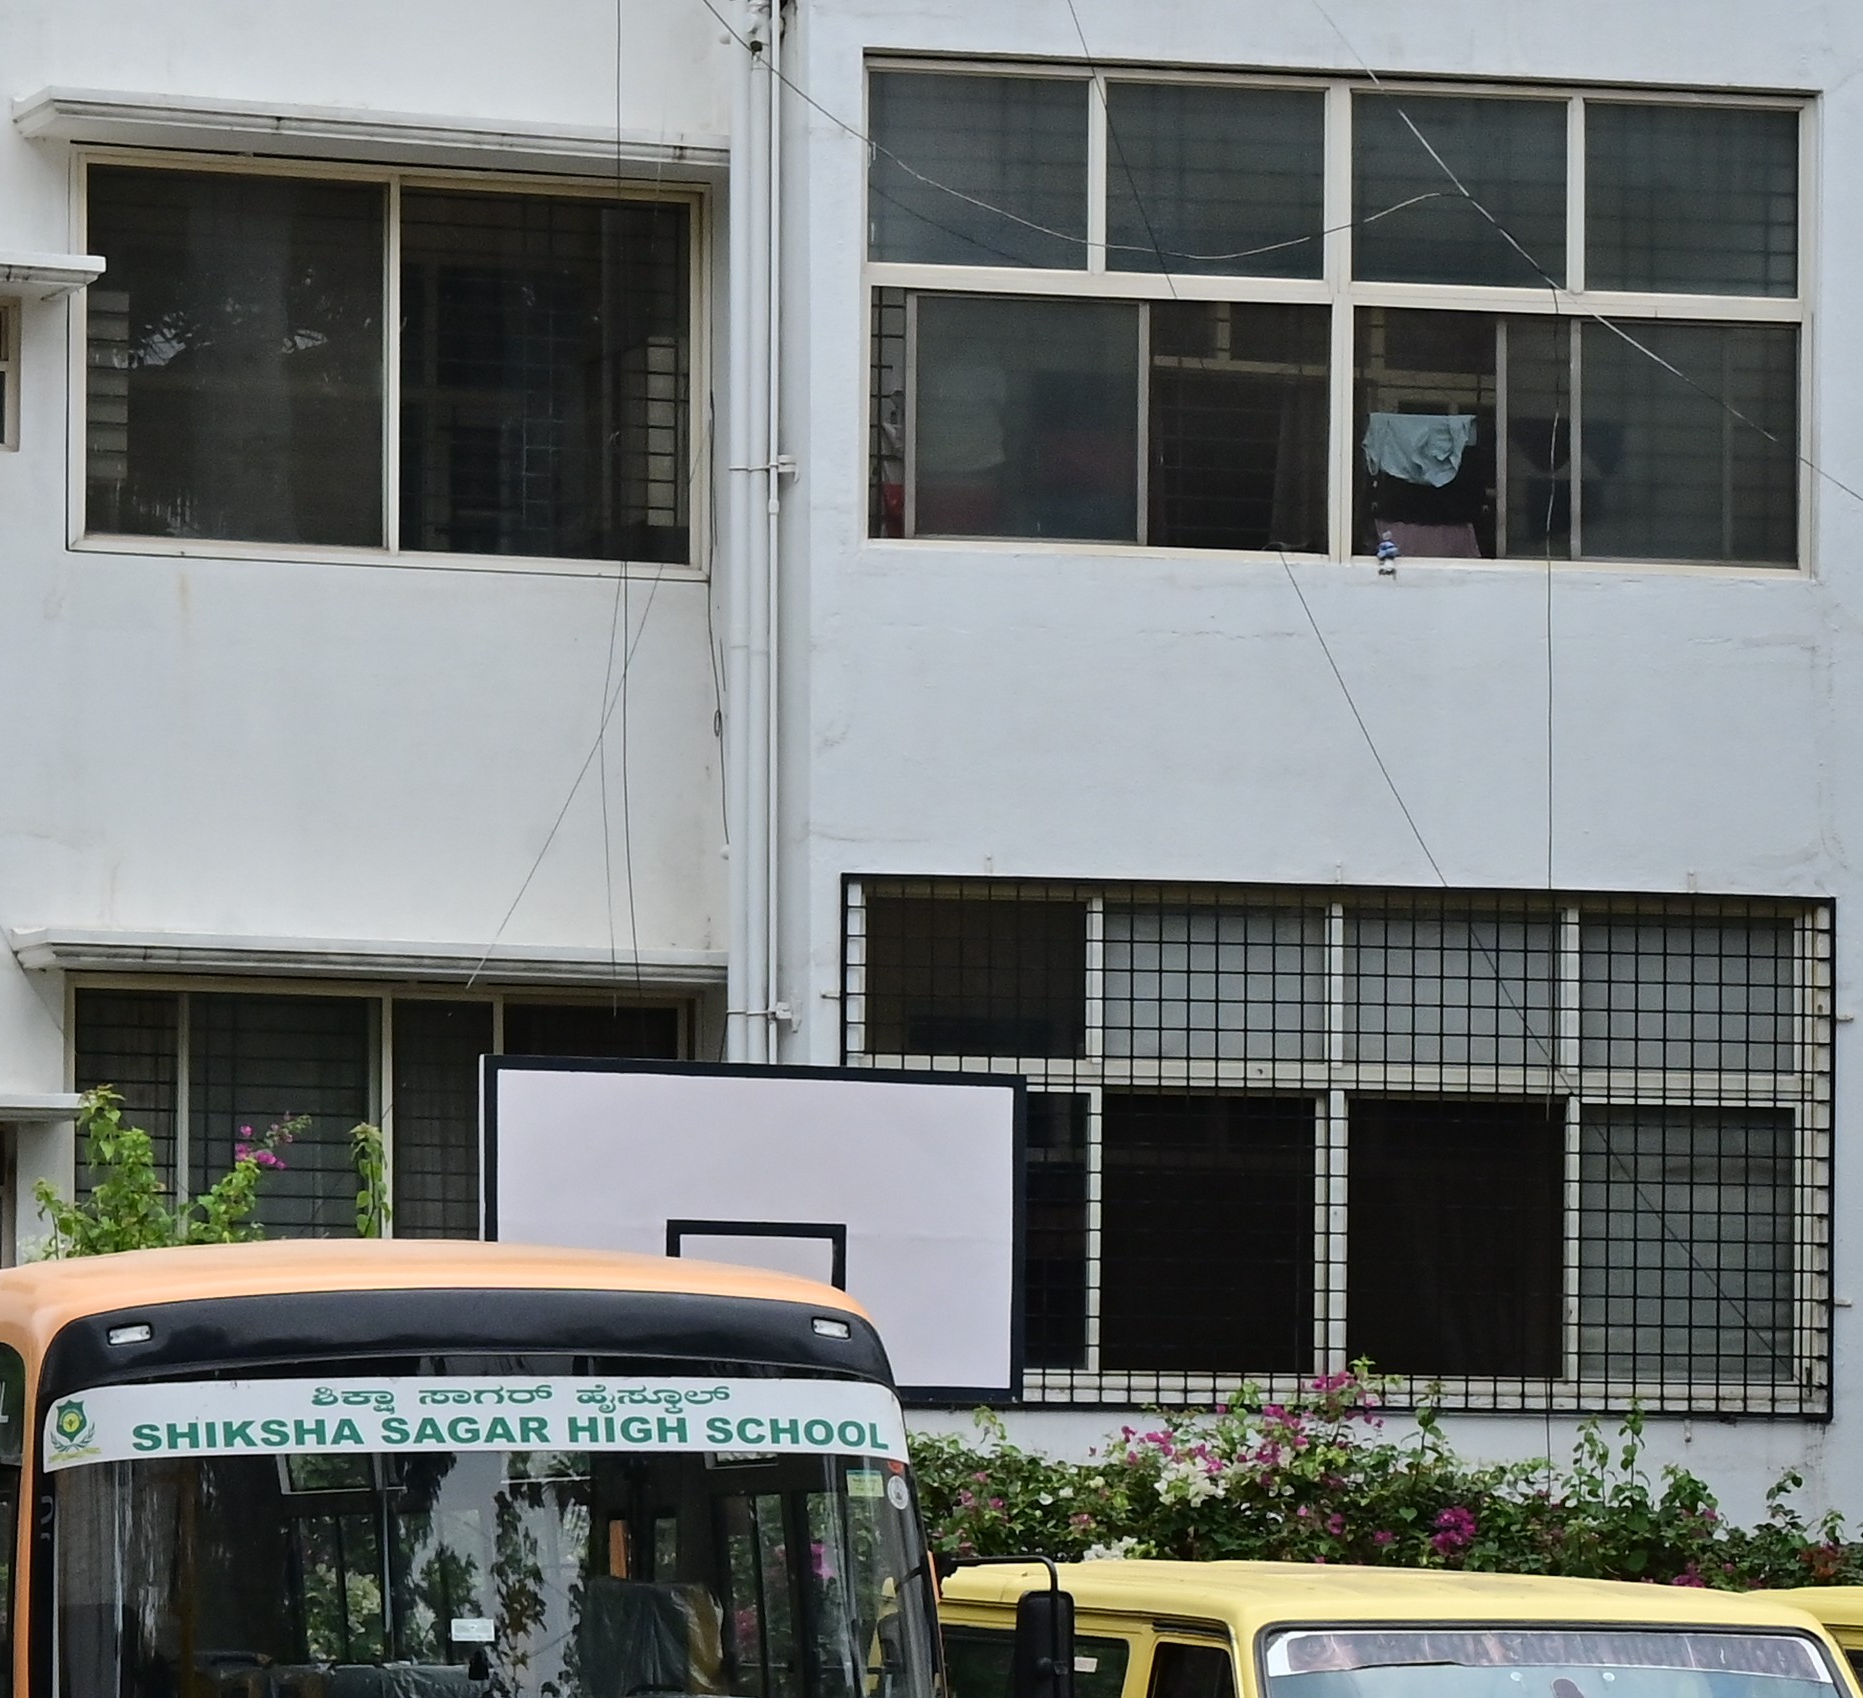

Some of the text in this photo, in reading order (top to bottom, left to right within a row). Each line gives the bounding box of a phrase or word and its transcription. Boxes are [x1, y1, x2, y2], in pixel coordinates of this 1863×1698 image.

[311, 1386, 396, 1414] ಶಿಕ್ಷಾ
[419, 1384, 553, 1406] ಸಾಗರ್
[132, 1416, 890, 1452] SHIKSHA SAGAR HIGH SCHOOL
